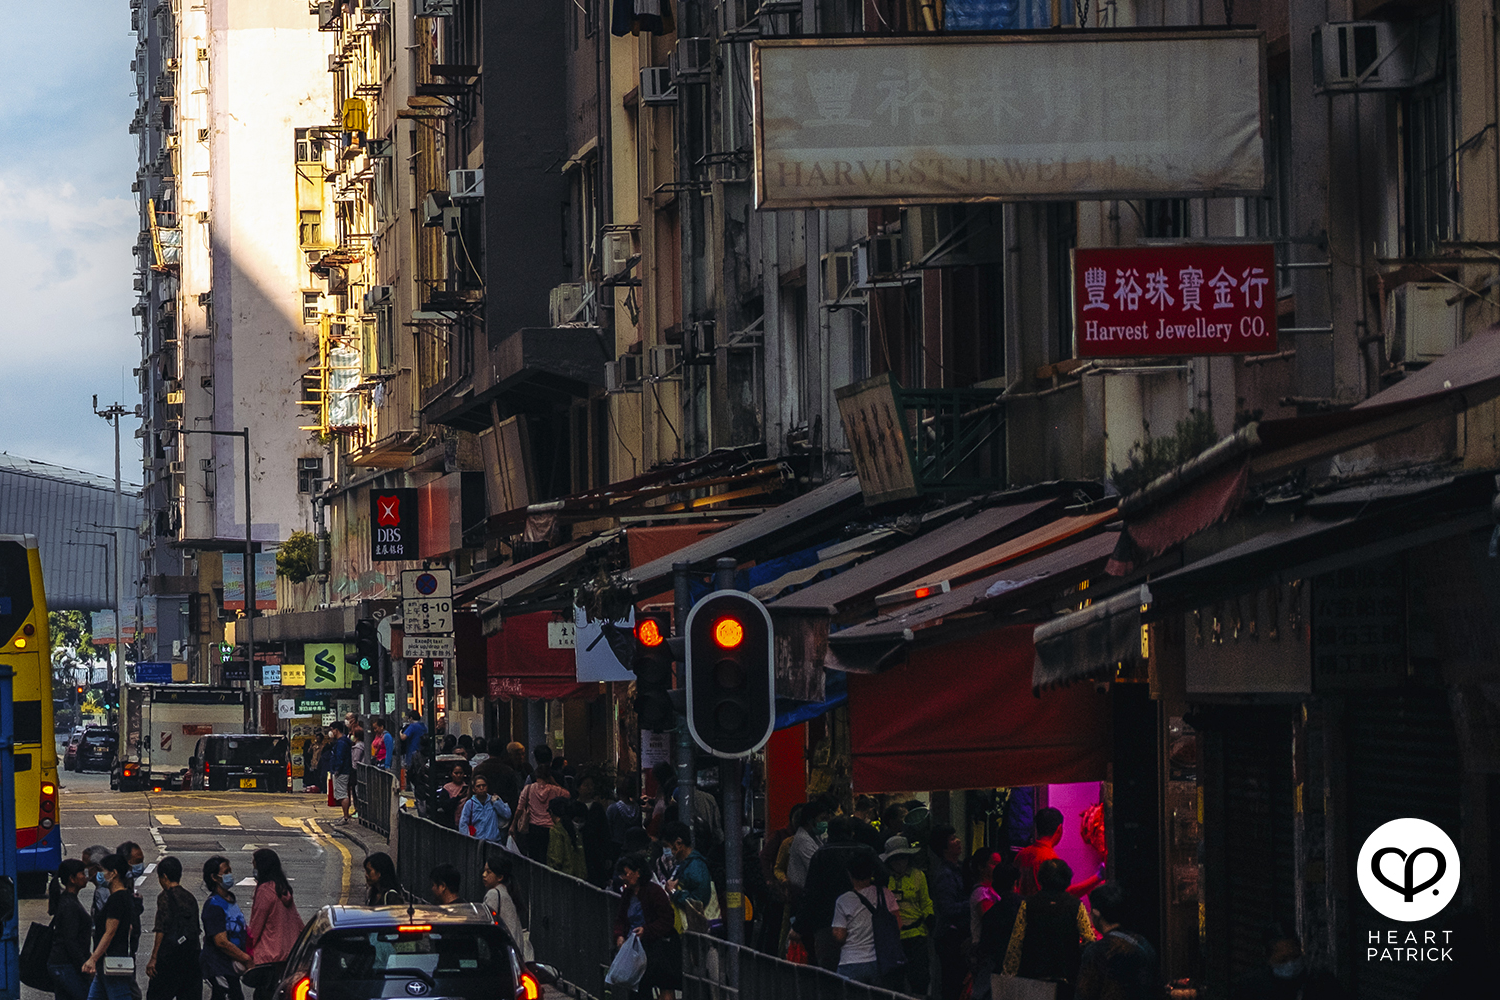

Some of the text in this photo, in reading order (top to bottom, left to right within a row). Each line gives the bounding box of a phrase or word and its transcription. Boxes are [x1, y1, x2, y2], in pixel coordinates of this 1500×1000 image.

[777, 156, 946, 188] HARVEST
[1083, 265, 1269, 311] 豐裕珠寶金行
[1085, 316, 1269, 342] Harvest Jewellery CO.
[377, 528, 401, 543] DBS
[422, 603, 449, 613] 8-10
[423, 619, 445, 629] 5-7
